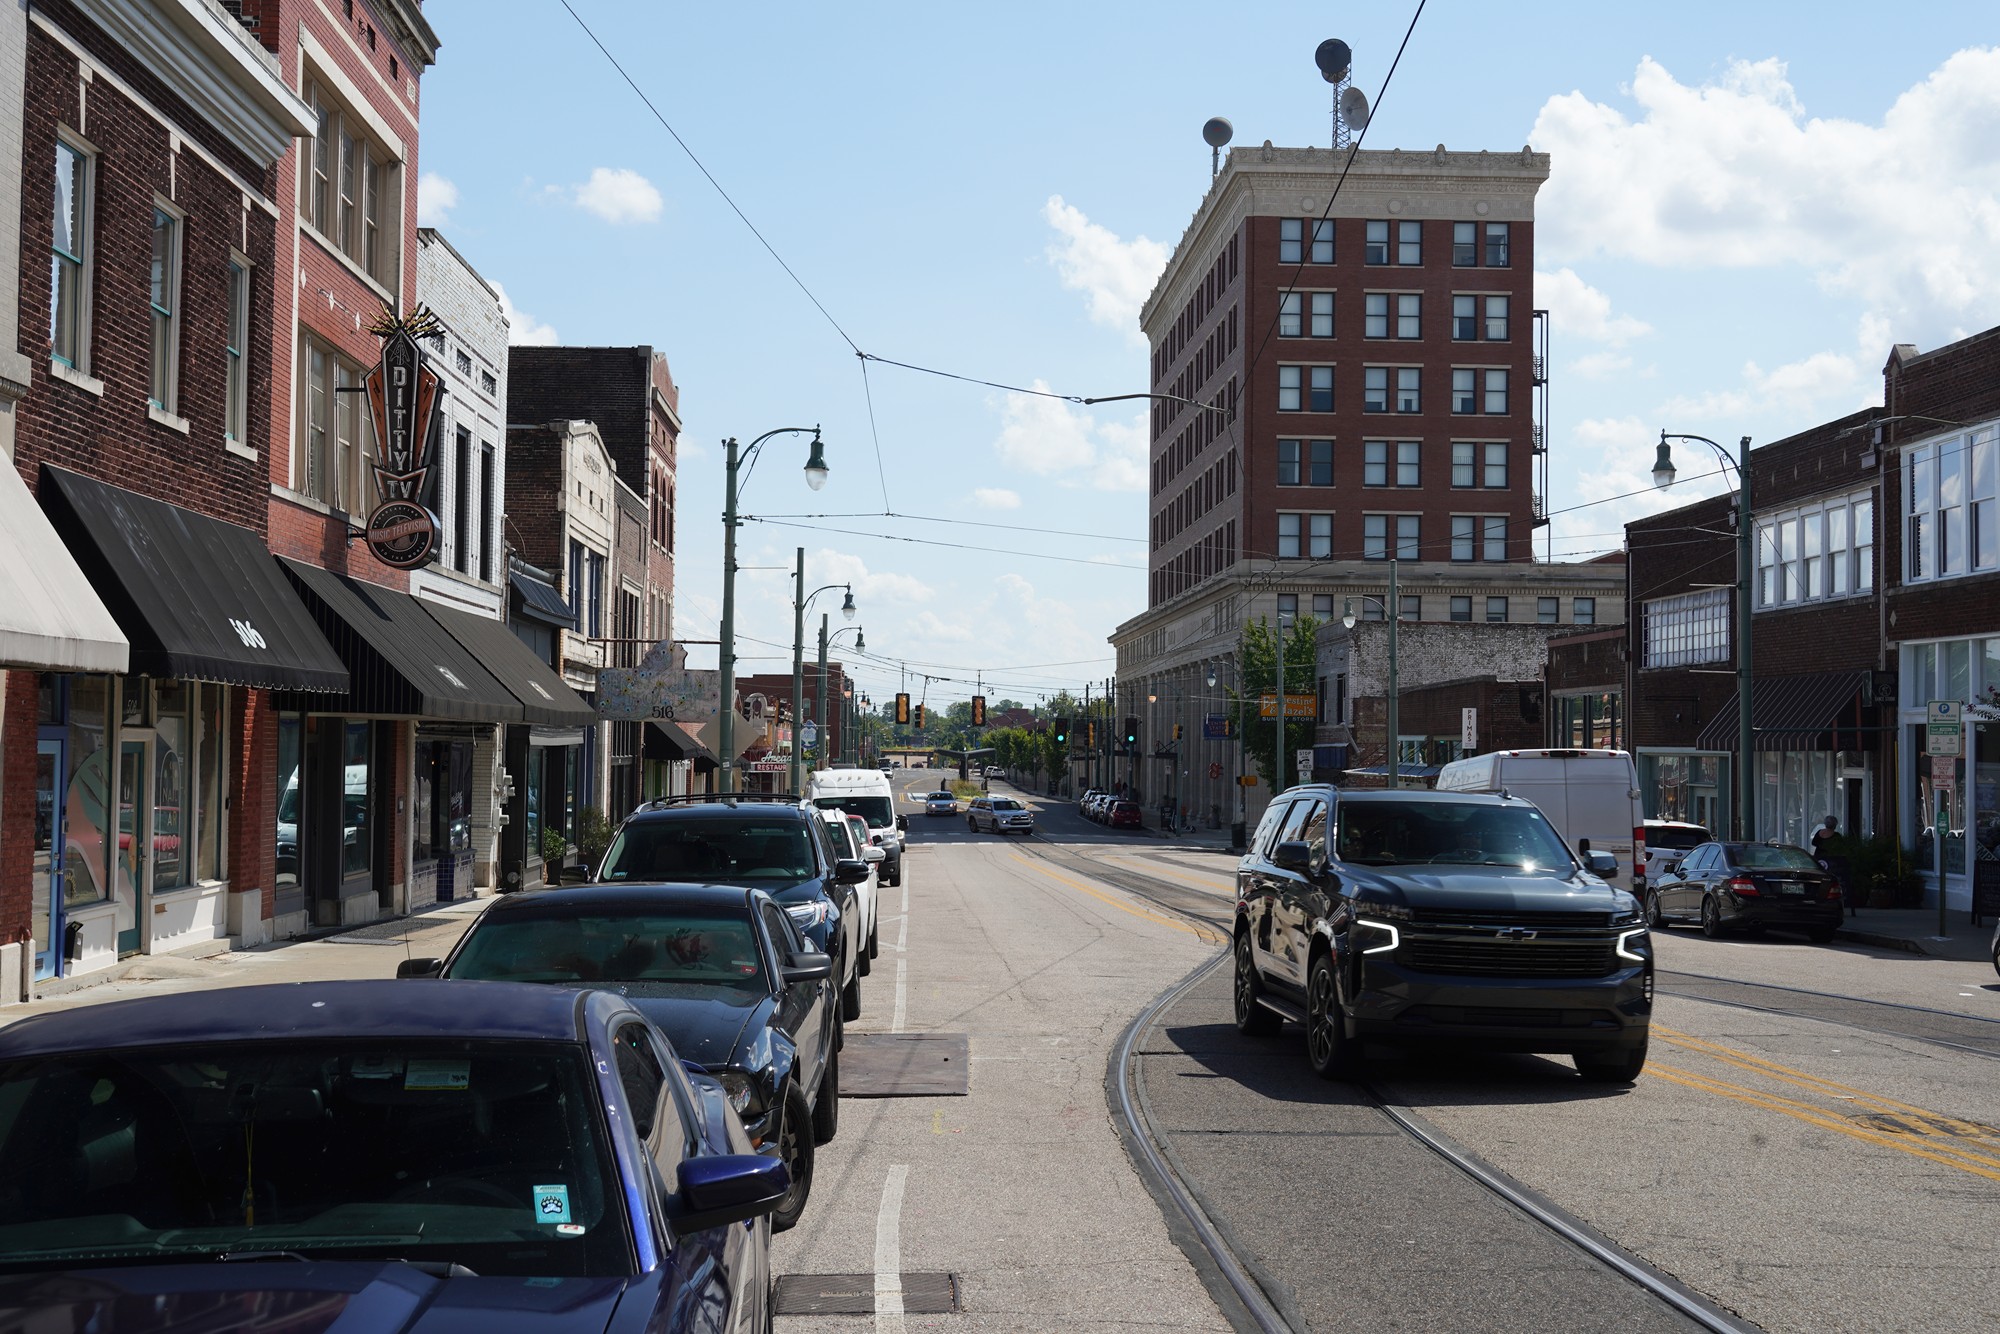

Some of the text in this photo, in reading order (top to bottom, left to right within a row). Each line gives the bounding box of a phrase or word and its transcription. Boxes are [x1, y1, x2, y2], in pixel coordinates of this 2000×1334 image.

[393, 366, 408, 471] DITTY
[387, 480, 413, 498] TV
[368, 519, 431, 542] MUSIC TELEVISION
[228, 617, 267, 649] 506
[652, 705, 674, 719] 516
